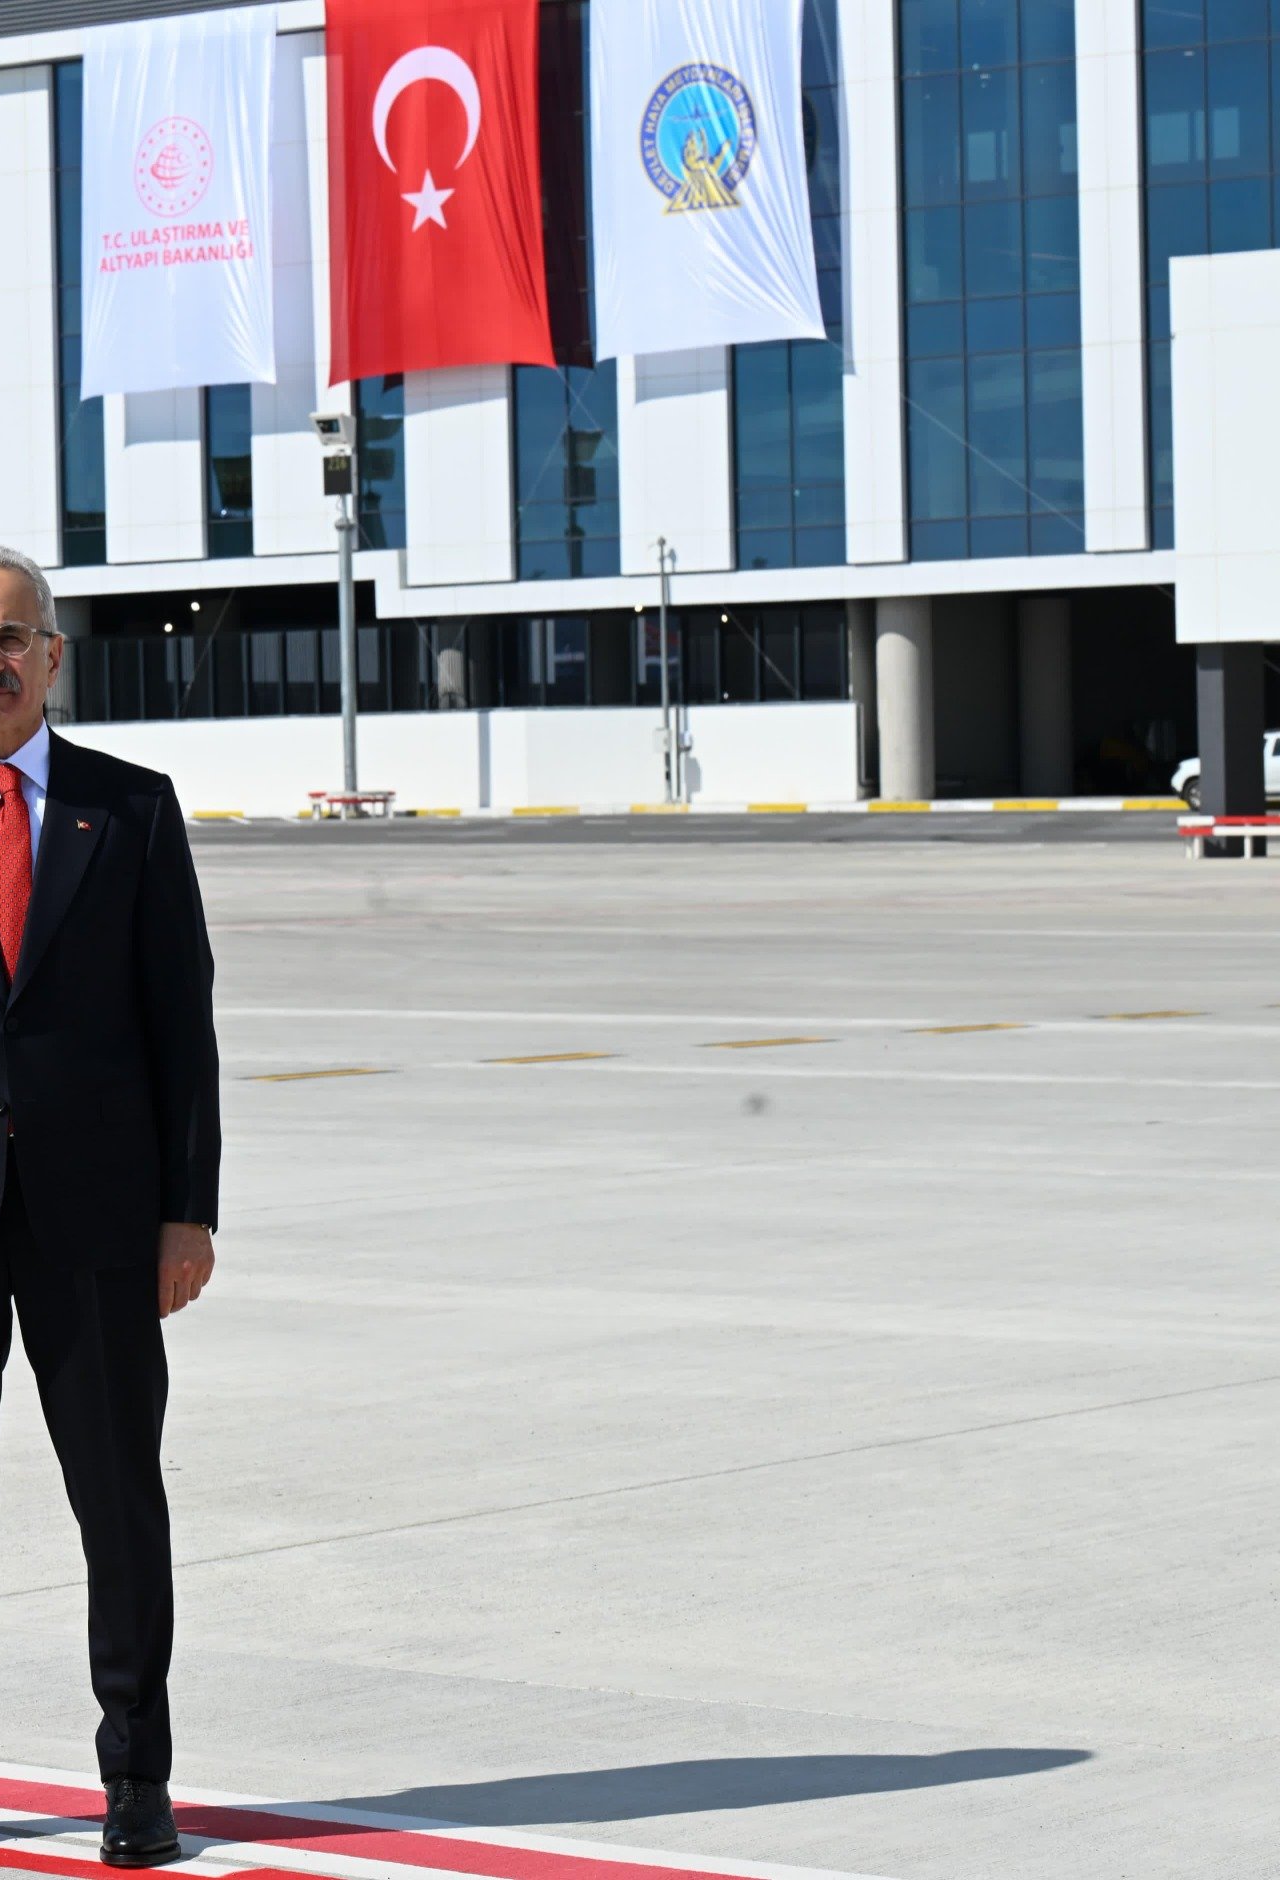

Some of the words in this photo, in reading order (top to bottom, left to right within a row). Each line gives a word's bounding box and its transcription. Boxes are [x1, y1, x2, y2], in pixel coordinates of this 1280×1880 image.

[644, 93, 667, 134] HAVA
[102, 232, 127, 250] T.C.
[131, 221, 223, 247] ULAŞTIRMA
[228, 219, 250, 236] VE
[100, 251, 158, 273] ALTYAPI
[162, 240, 254, 266] BAKANLIĞI
